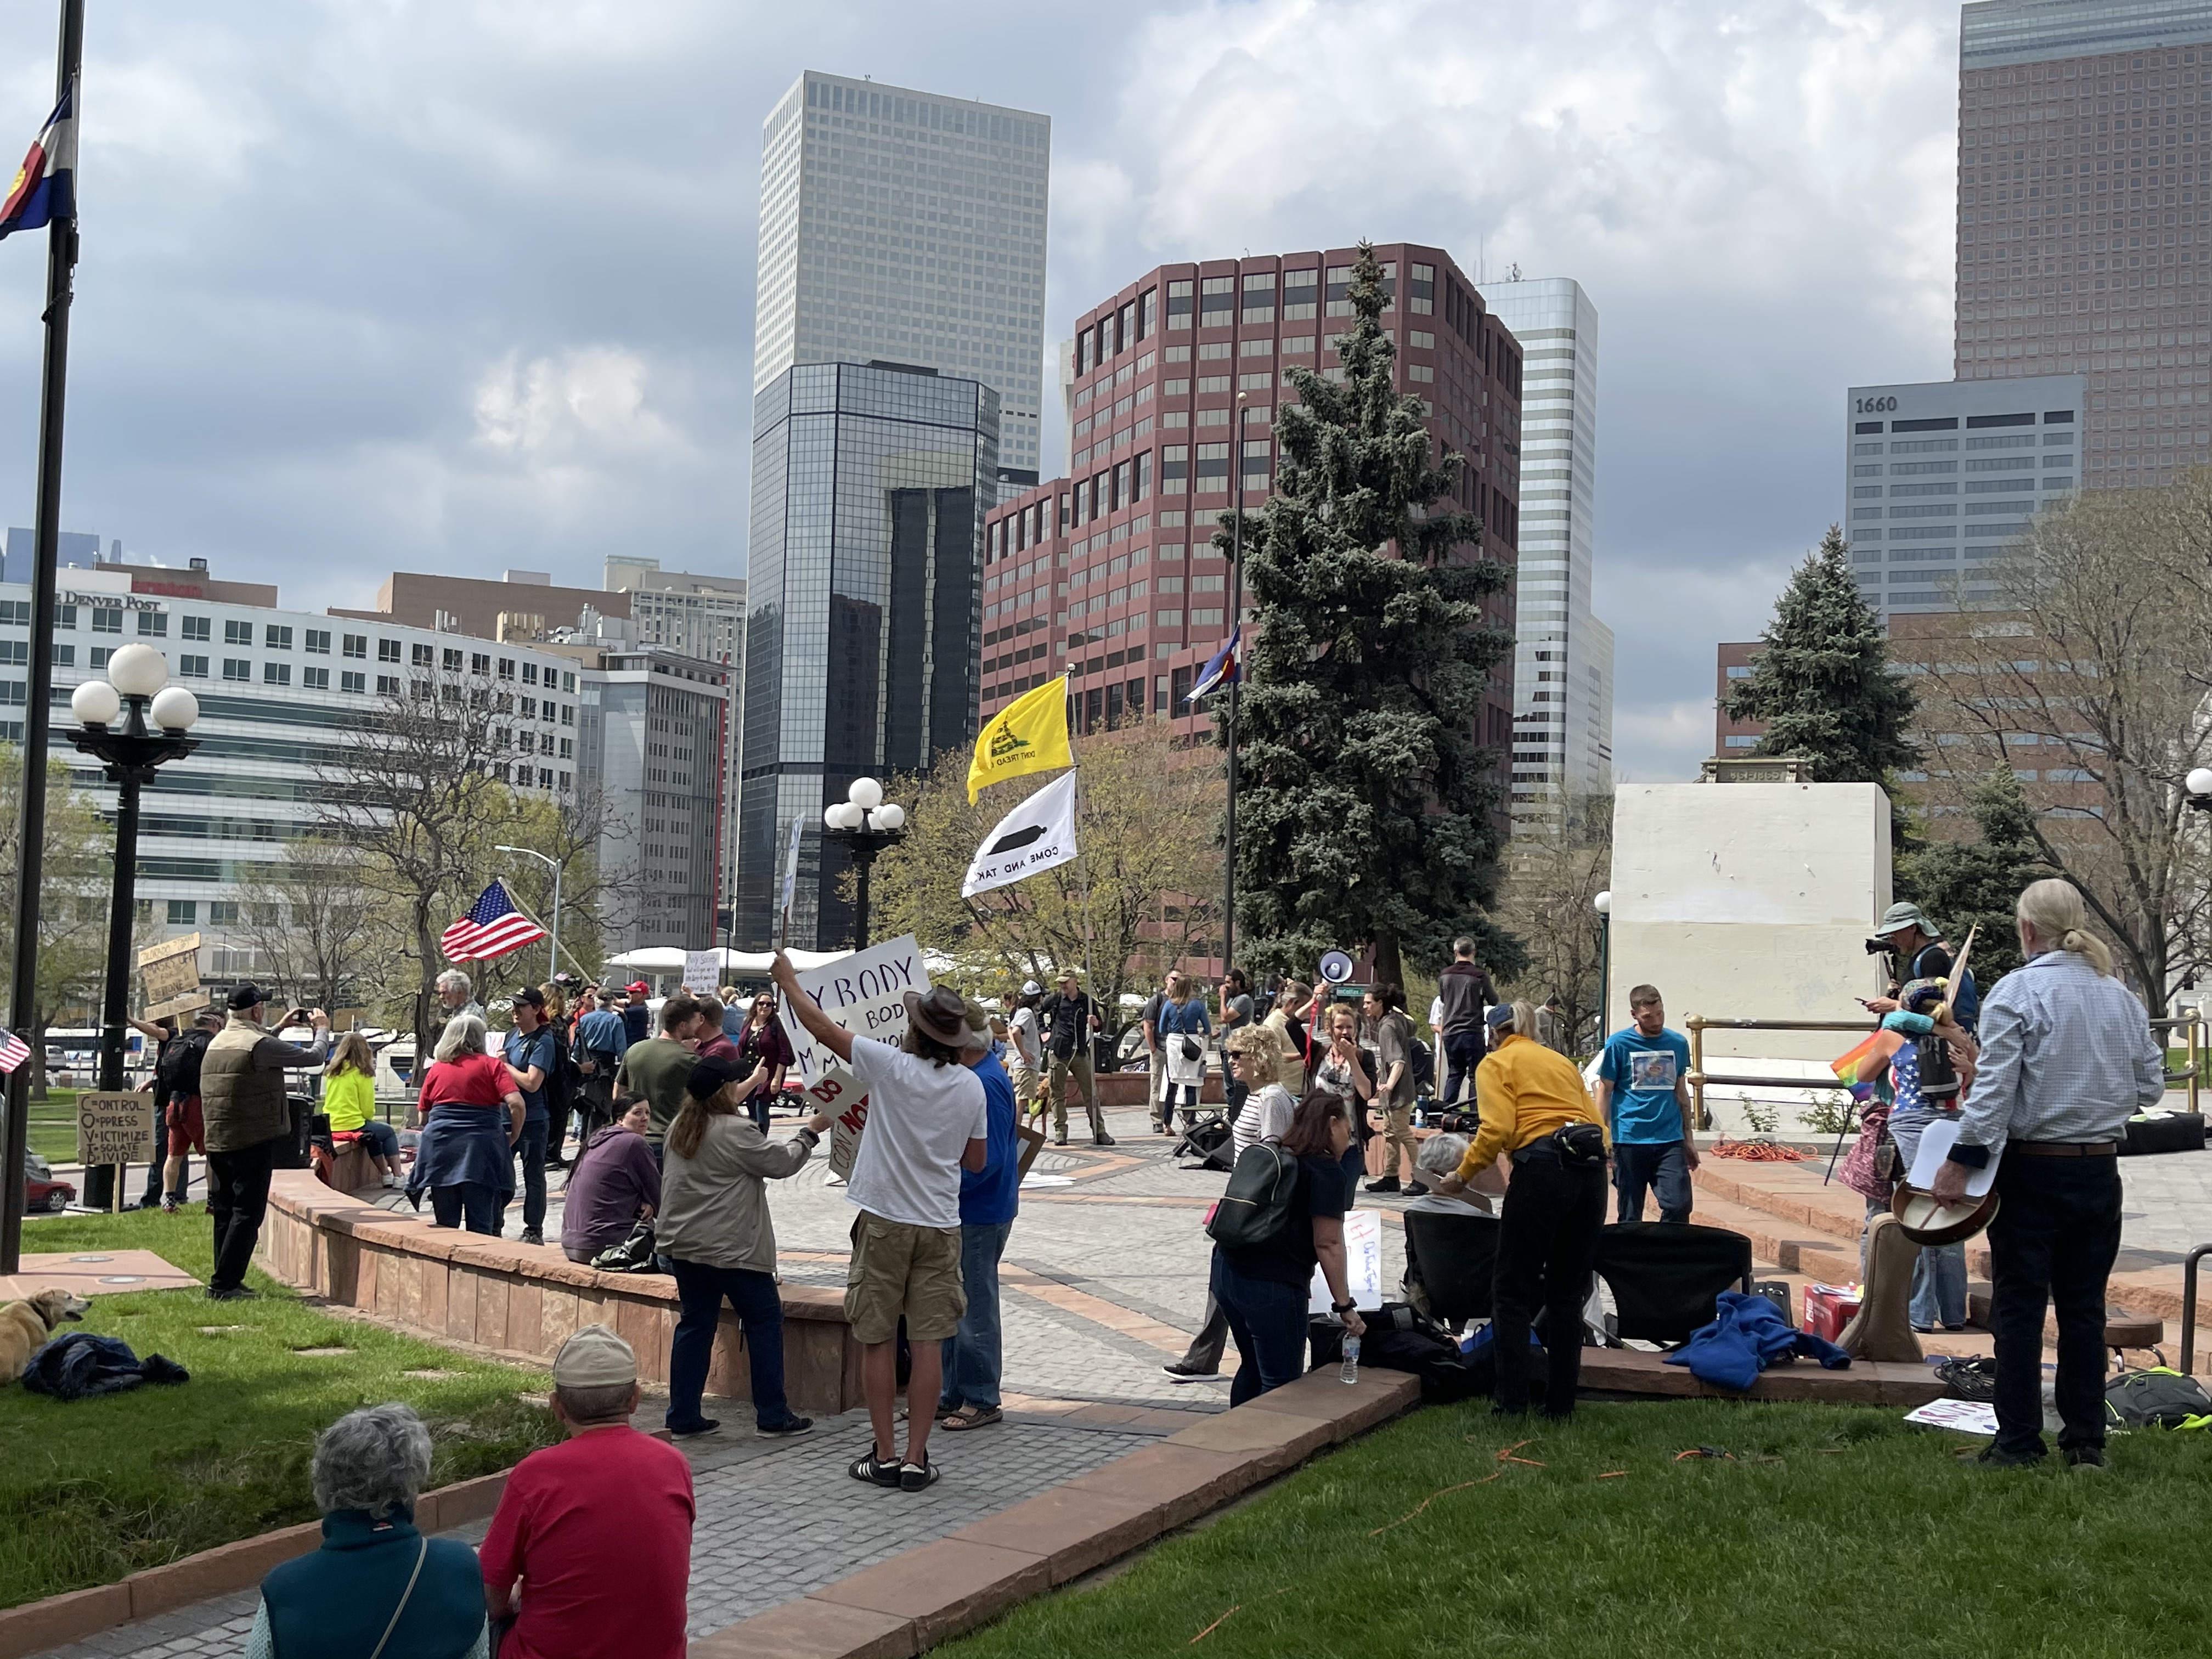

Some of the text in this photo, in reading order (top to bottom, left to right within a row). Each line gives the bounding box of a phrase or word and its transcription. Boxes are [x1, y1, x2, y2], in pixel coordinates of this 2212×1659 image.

[1855, 396, 1897, 413] 1660
[65, 591, 124, 609] DENVER
[123, 594, 161, 612] POST
[976, 846, 1059, 881] COME AND TAK
[834, 956, 912, 1007] BODY
[866, 1003, 905, 1030] BOD
[810, 1079, 843, 1103] DO
